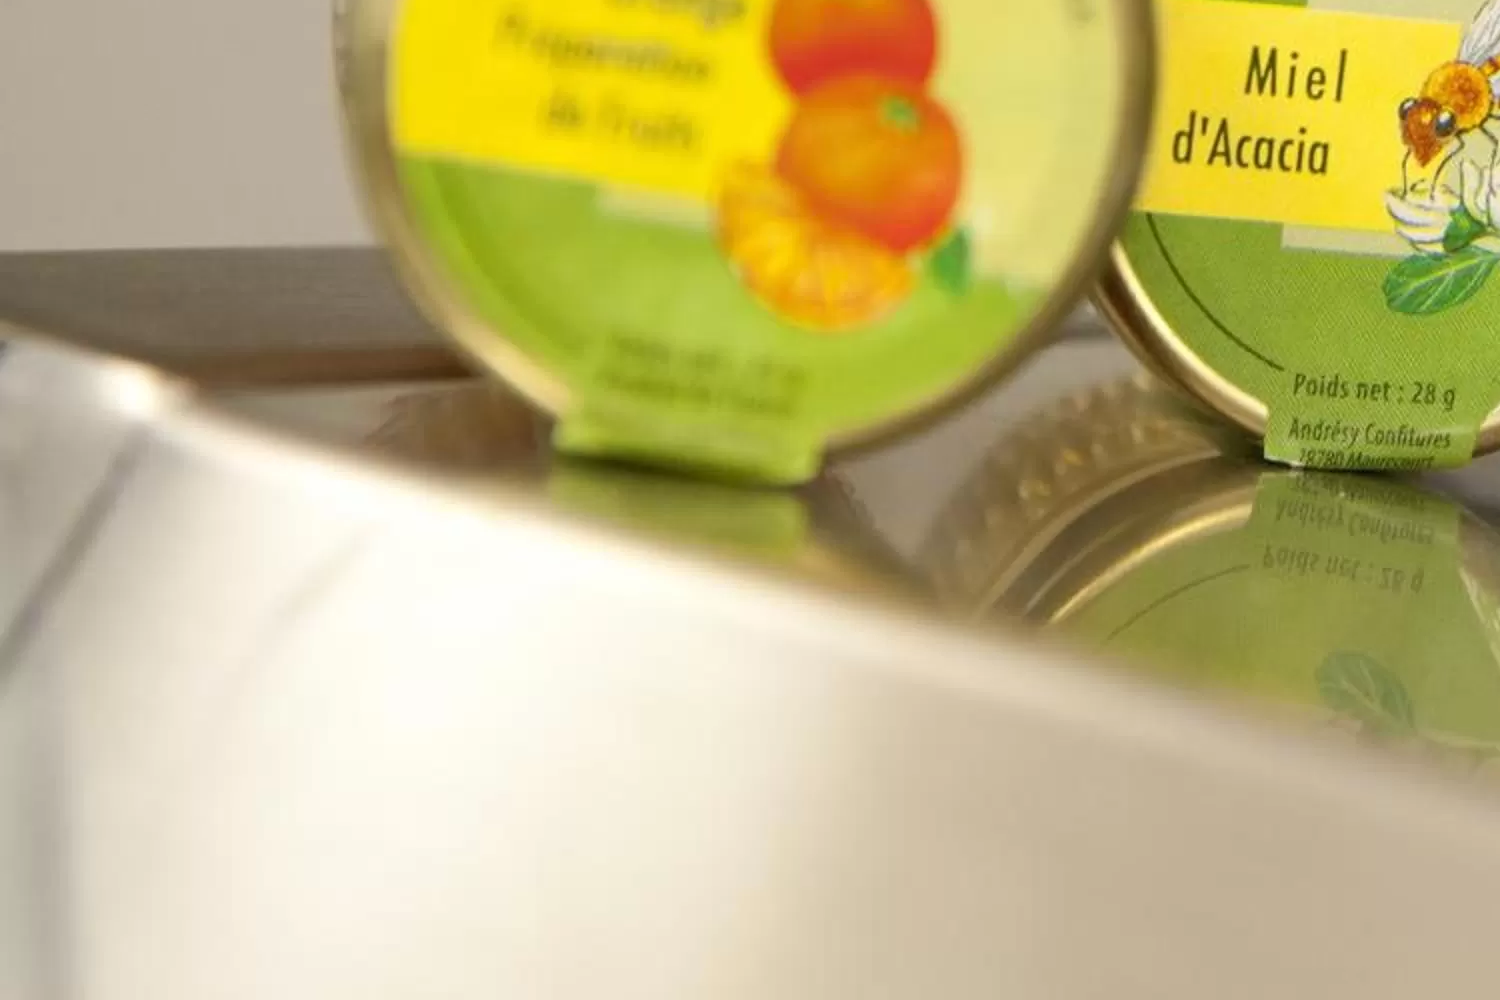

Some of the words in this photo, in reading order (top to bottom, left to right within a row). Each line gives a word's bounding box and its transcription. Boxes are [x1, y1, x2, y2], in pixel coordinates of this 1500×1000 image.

[1244, 45, 1348, 103] Miel
[1171, 110, 1330, 176] d'Acacia
[1293, 373, 1350, 400] Poids
[1355, 378, 1392, 401] net
[1411, 381, 1437, 405] 28
[1443, 387, 1456, 410] g
[1365, 423, 1451, 449] Confitures
